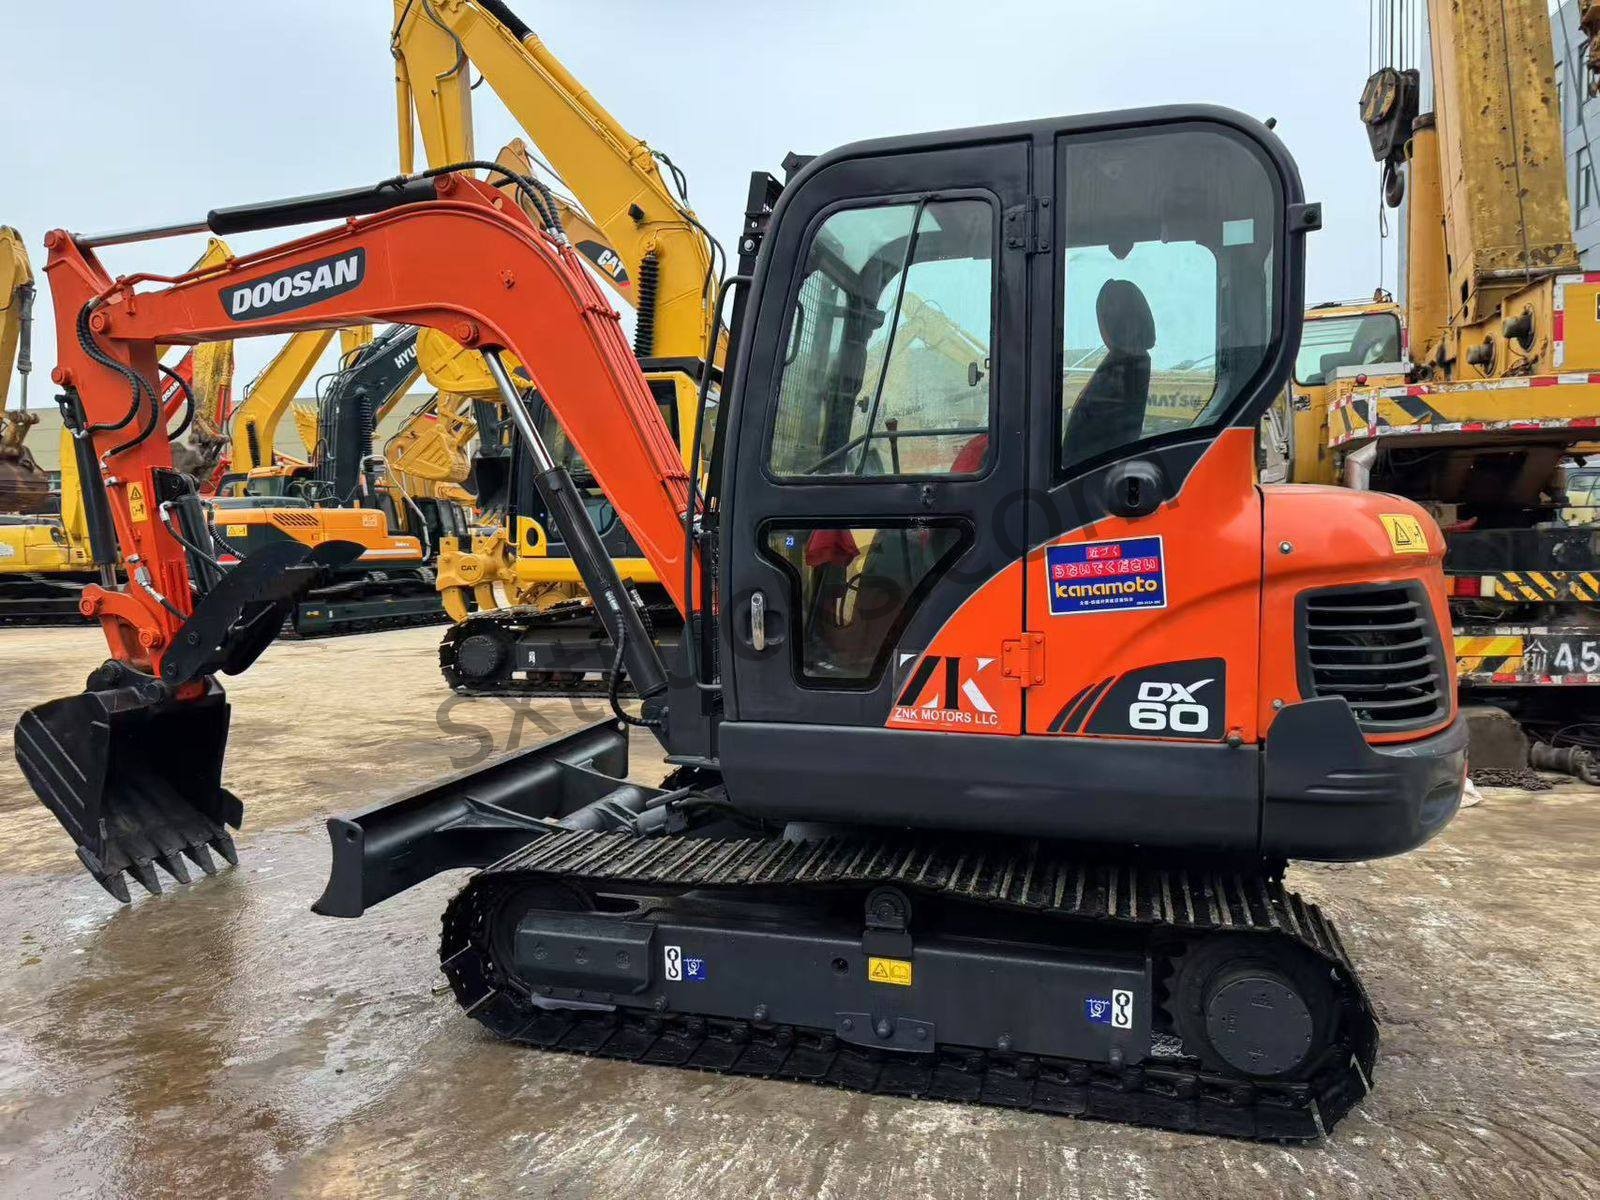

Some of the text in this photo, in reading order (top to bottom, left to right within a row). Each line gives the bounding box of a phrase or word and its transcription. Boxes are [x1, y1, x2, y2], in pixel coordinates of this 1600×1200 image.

[597, 249, 625, 278] CAT
[231, 255, 359, 315] DOOSAN
[461, 564, 477, 572] CAT
[1055, 576, 1158, 598] kanamoto
[1138, 678, 1215, 703] DX
[895, 707, 998, 725] ZNK MOTORS LLC
[1129, 701, 1209, 733] 60
